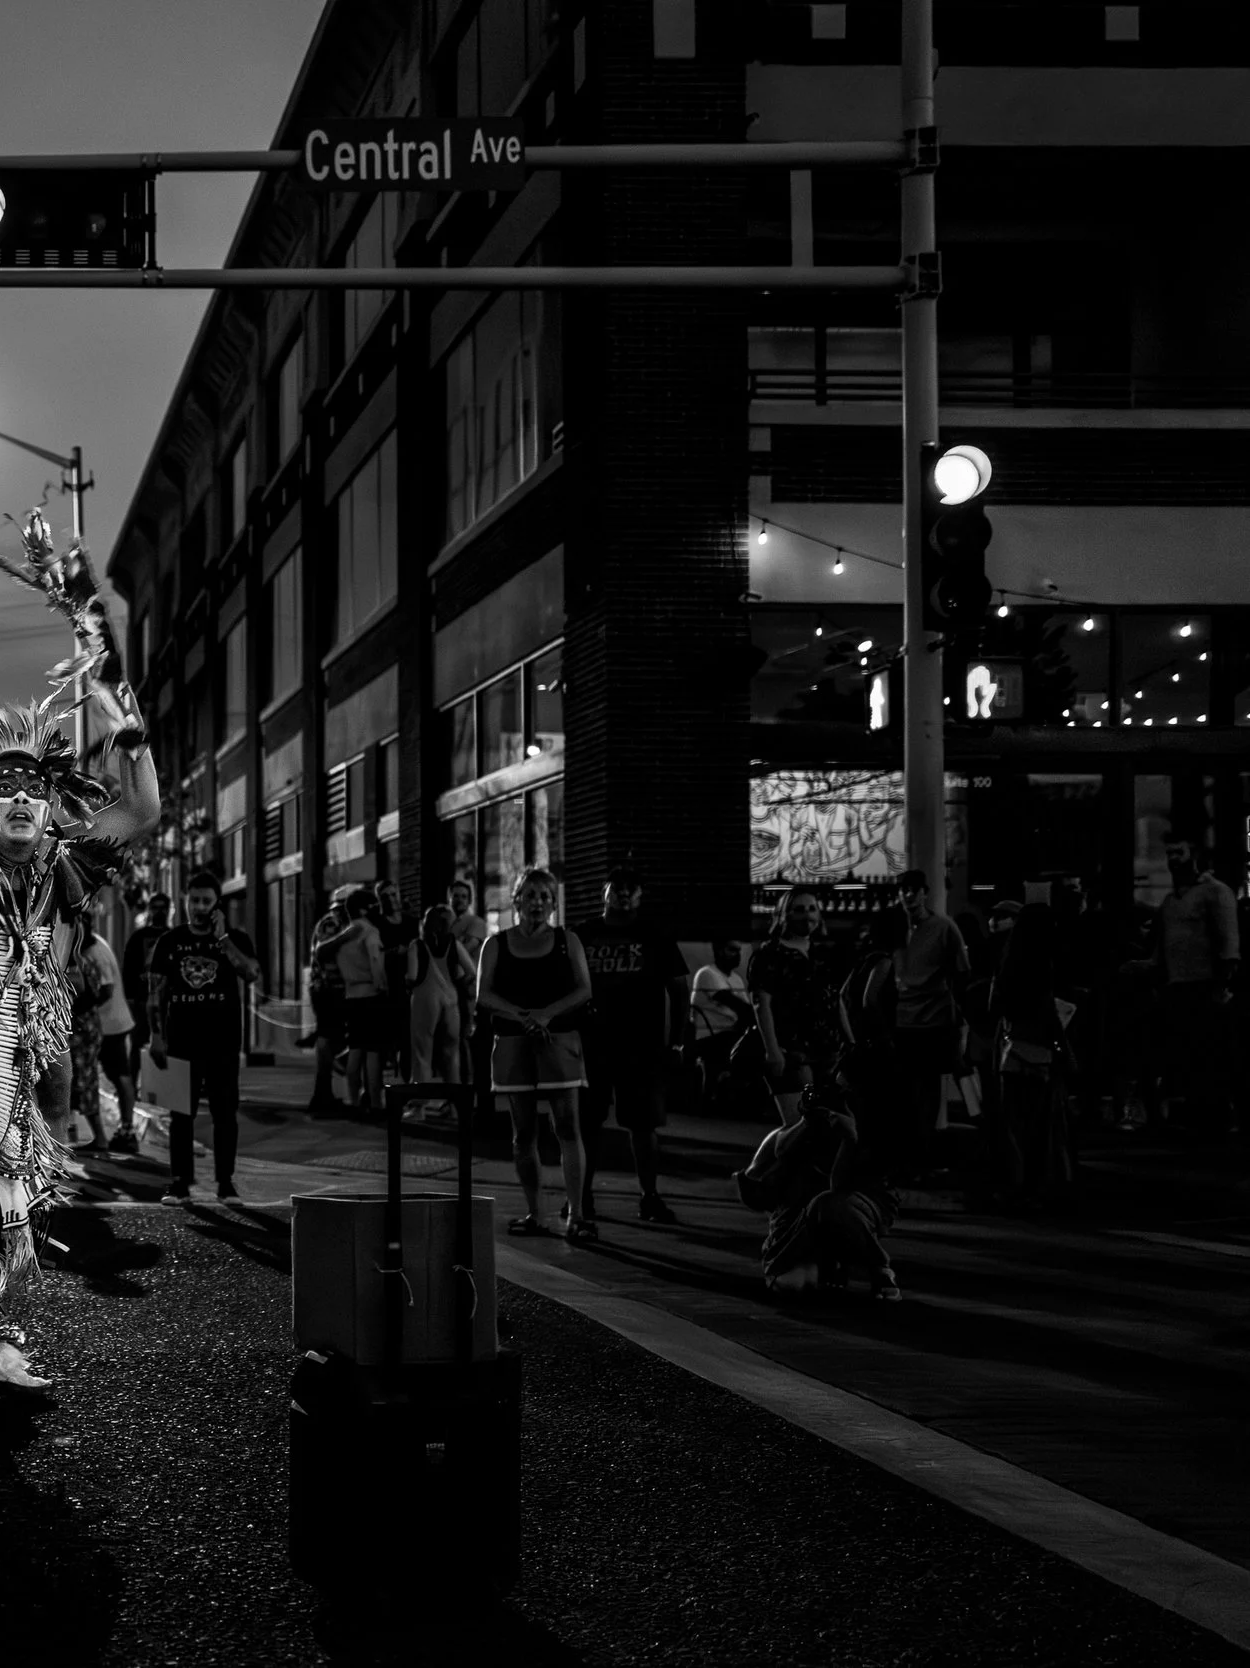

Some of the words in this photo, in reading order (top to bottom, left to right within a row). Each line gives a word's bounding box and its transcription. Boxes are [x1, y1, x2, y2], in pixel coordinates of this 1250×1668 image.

[305, 128, 452, 181] Central
[470, 127, 521, 164] Ave
[972, 775, 992, 788] 100
